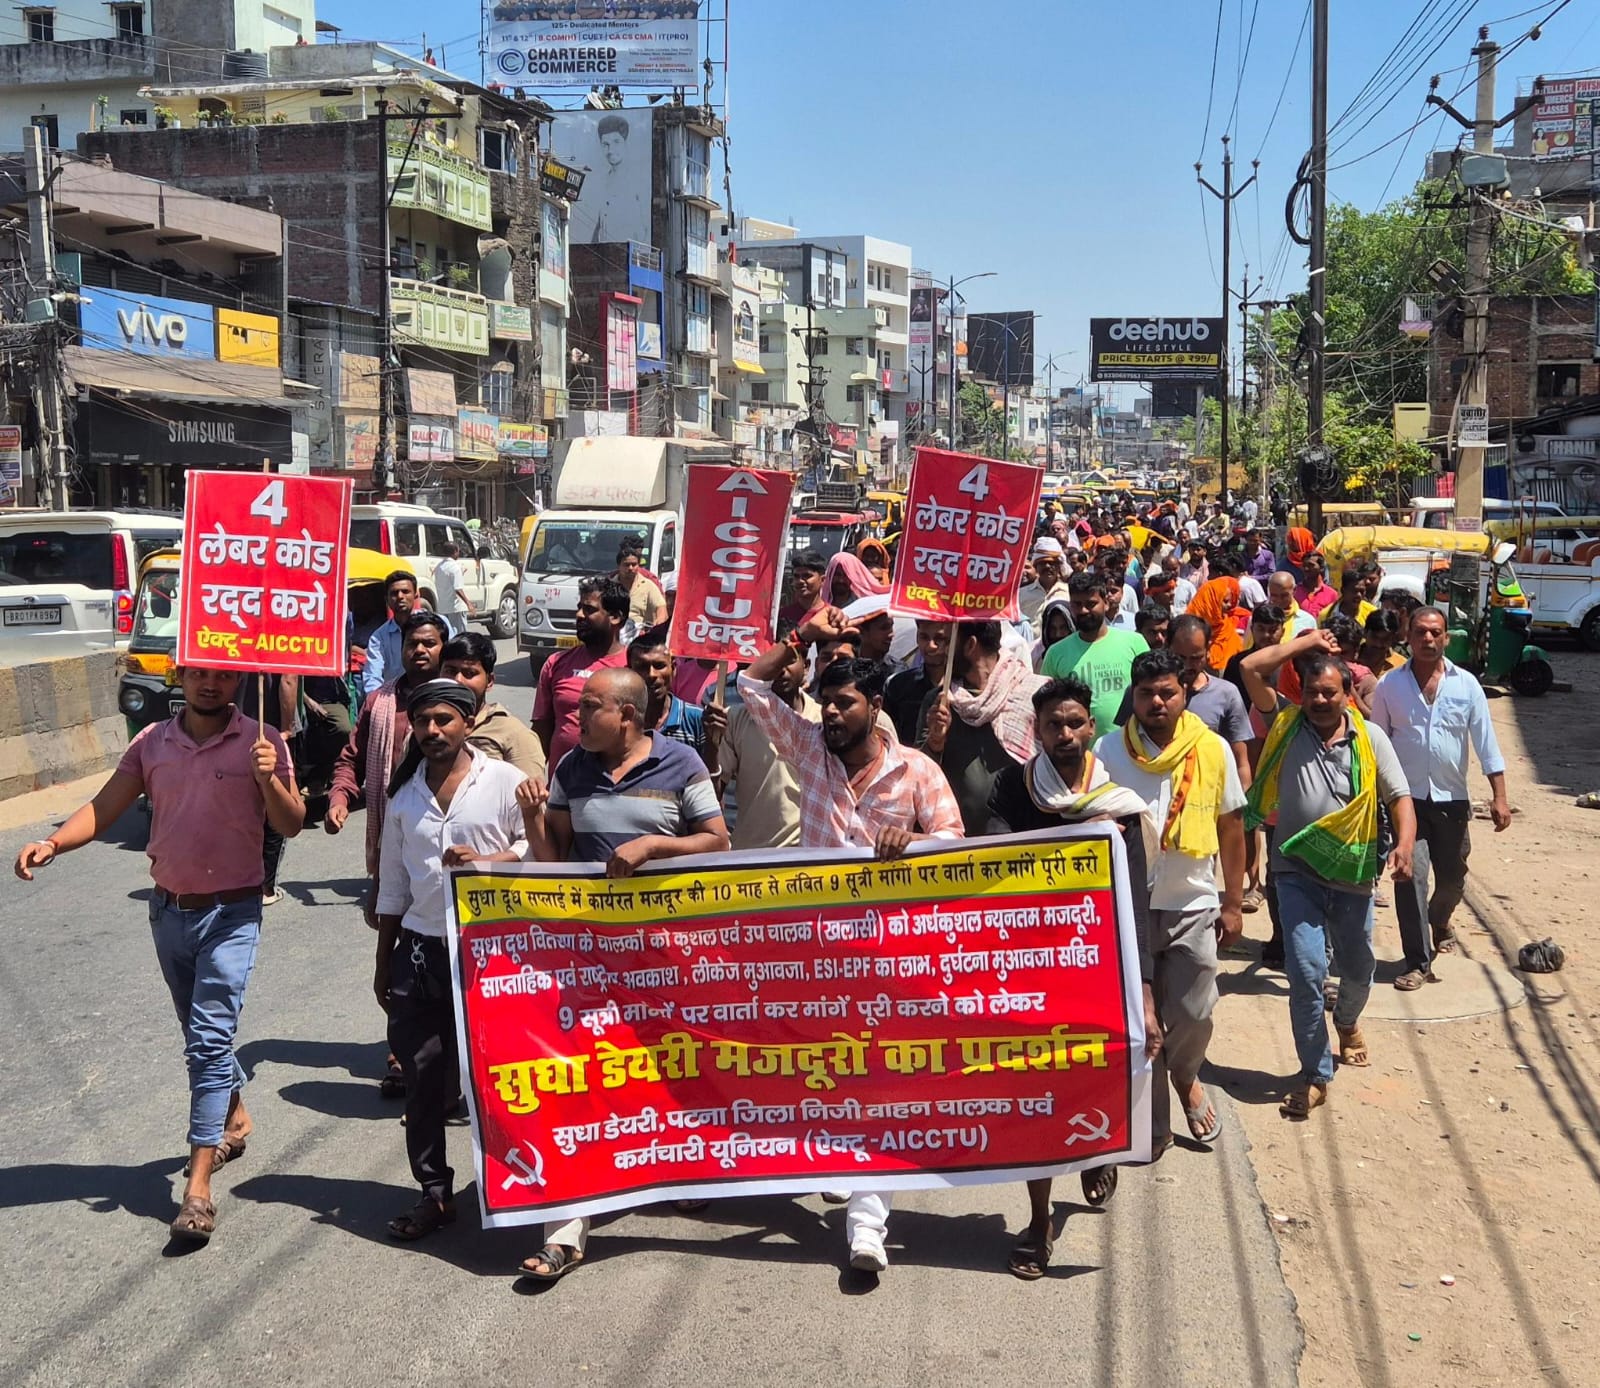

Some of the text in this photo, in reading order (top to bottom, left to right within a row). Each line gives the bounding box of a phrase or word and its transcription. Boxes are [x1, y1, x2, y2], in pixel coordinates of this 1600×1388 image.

[527, 47, 617, 60] CHARTERED
[527, 60, 617, 74] COMMERCE
[117, 301, 187, 348] vivo
[1109, 318, 1209, 340] deehub
[1102, 355, 1132, 363] PRICE
[1135, 355, 1172, 363] STARTS
[1126, 344, 1191, 352] LIFESTYLE
[168, 420, 235, 442] SAMSUNG
[250, 480, 288, 525] 4
[958, 463, 989, 501] 4
[915, 494, 1024, 544] लेबर कोड
[199, 522, 335, 575] लेबर कोड
[704, 471, 768, 619] AICCTU
[966, 549, 1012, 584] करो
[270, 580, 327, 621] करो
[687, 614, 760, 657] ऐक्टू
[467, 889, 496, 917] सुधा
[500, 890, 522, 914] दूध
[570, 886, 582, 909] में
[587, 884, 634, 911] कार्यरत
[639, 890, 684, 915] मजदूर
[687, 880, 706, 902] की
[713, 883, 732, 901] 10
[737, 878, 763, 899] माह
[767, 875, 780, 895] से
[786, 871, 824, 894] लंबित
[831, 874, 839, 892] 9
[845, 870, 873, 898] सूत्री
[878, 863, 912, 886] मांगों
[918, 866, 937, 884] पर
[943, 854, 975, 882] वार्ता
[980, 862, 1004, 879] कर
[1006, 853, 1037, 879] मांगें
[1041, 849, 1066, 885] पूरी
[1072, 848, 1098, 875] करो
[471, 934, 502, 969] सुधा
[504, 932, 528, 964] दूध
[577, 927, 593, 952] के
[596, 928, 645, 953] चालकों
[648, 927, 671, 948] को
[672, 928, 717, 957] कुशल
[719, 919, 740, 946] एवं
[743, 925, 765, 943] उप
[767, 921, 813, 942] चालक
[817, 908, 884, 948] (खलासी)
[887, 908, 909, 936] को
[912, 904, 982, 944] अर्धकुशल
[983, 907, 1041, 940] न्यूनतम
[1042, 895, 1101, 935] मजदूरी,
[480, 964, 552, 999] साप्ताहिक
[555, 960, 576, 990] एवं
[622, 965, 679, 990] अवकाश
[691, 955, 740, 984] लीकेज
[742, 961, 810, 991] मुआवजा,
[814, 957, 870, 980] ESI-EPF
[874, 957, 896, 977] का
[897, 955, 936, 979] लाभ,
[939, 944, 990, 985] दुर्घटना
[991, 947, 1055, 981] मुआवजा
[1056, 936, 1099, 968] सहित
[559, 1006, 575, 1031] 9
[579, 999, 621, 1036] सूत्री
[681, 1004, 710, 1025] पर
[713, 997, 759, 1021] वार्ता
[763, 1000, 799, 1020] कर
[802, 995, 850, 1018] मांगें
[857, 993, 892, 1026] पूरी
[896, 991, 950, 1018] करने
[953, 988, 982, 1016] को
[988, 988, 1046, 1016] लेकर
[488, 1024, 1110, 1115] सुधा डेयरी मजदूरों का प्रदर्शन
[551, 1119, 600, 1157] सुधा
[731, 1097, 796, 1125] जिला
[800, 1097, 861, 1121] निजी
[866, 1102, 931, 1120] वाहन
[935, 1097, 1013, 1117] चालक
[1017, 1090, 1055, 1117] एवं
[613, 1135, 705, 1170] कर्मचारी
[709, 1132, 797, 1170] यूनियन
